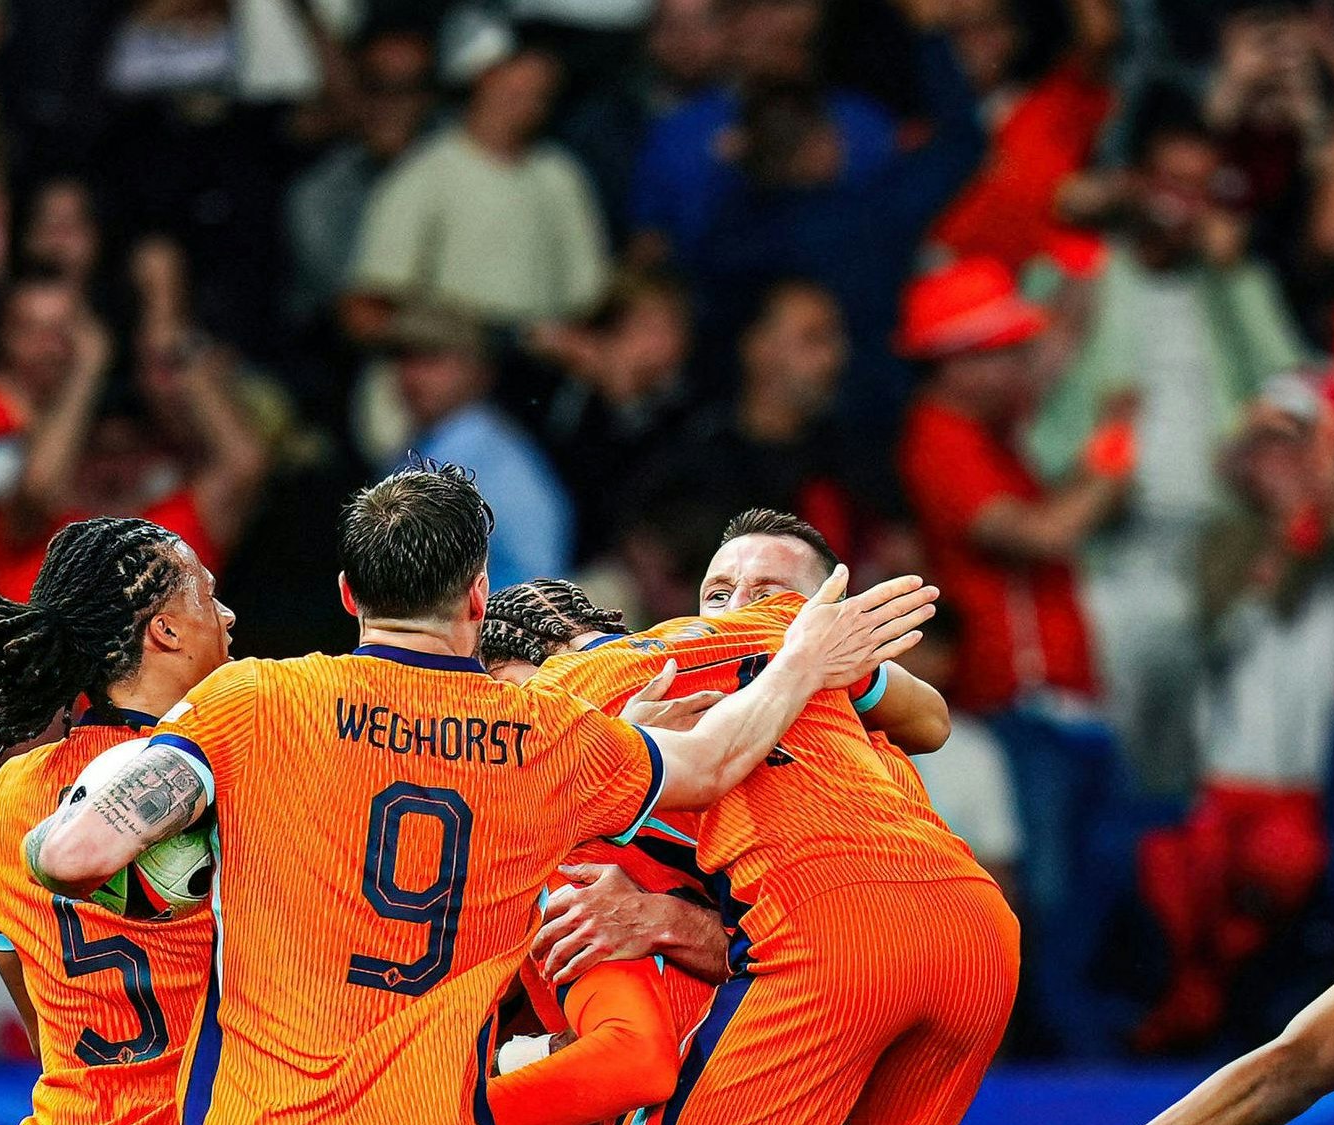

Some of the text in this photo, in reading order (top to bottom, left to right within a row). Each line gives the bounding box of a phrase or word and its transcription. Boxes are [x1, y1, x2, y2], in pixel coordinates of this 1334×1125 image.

[335, 697, 532, 768] WEGHORST
[346, 780, 474, 997] 9
[53, 893, 170, 1067] 5
